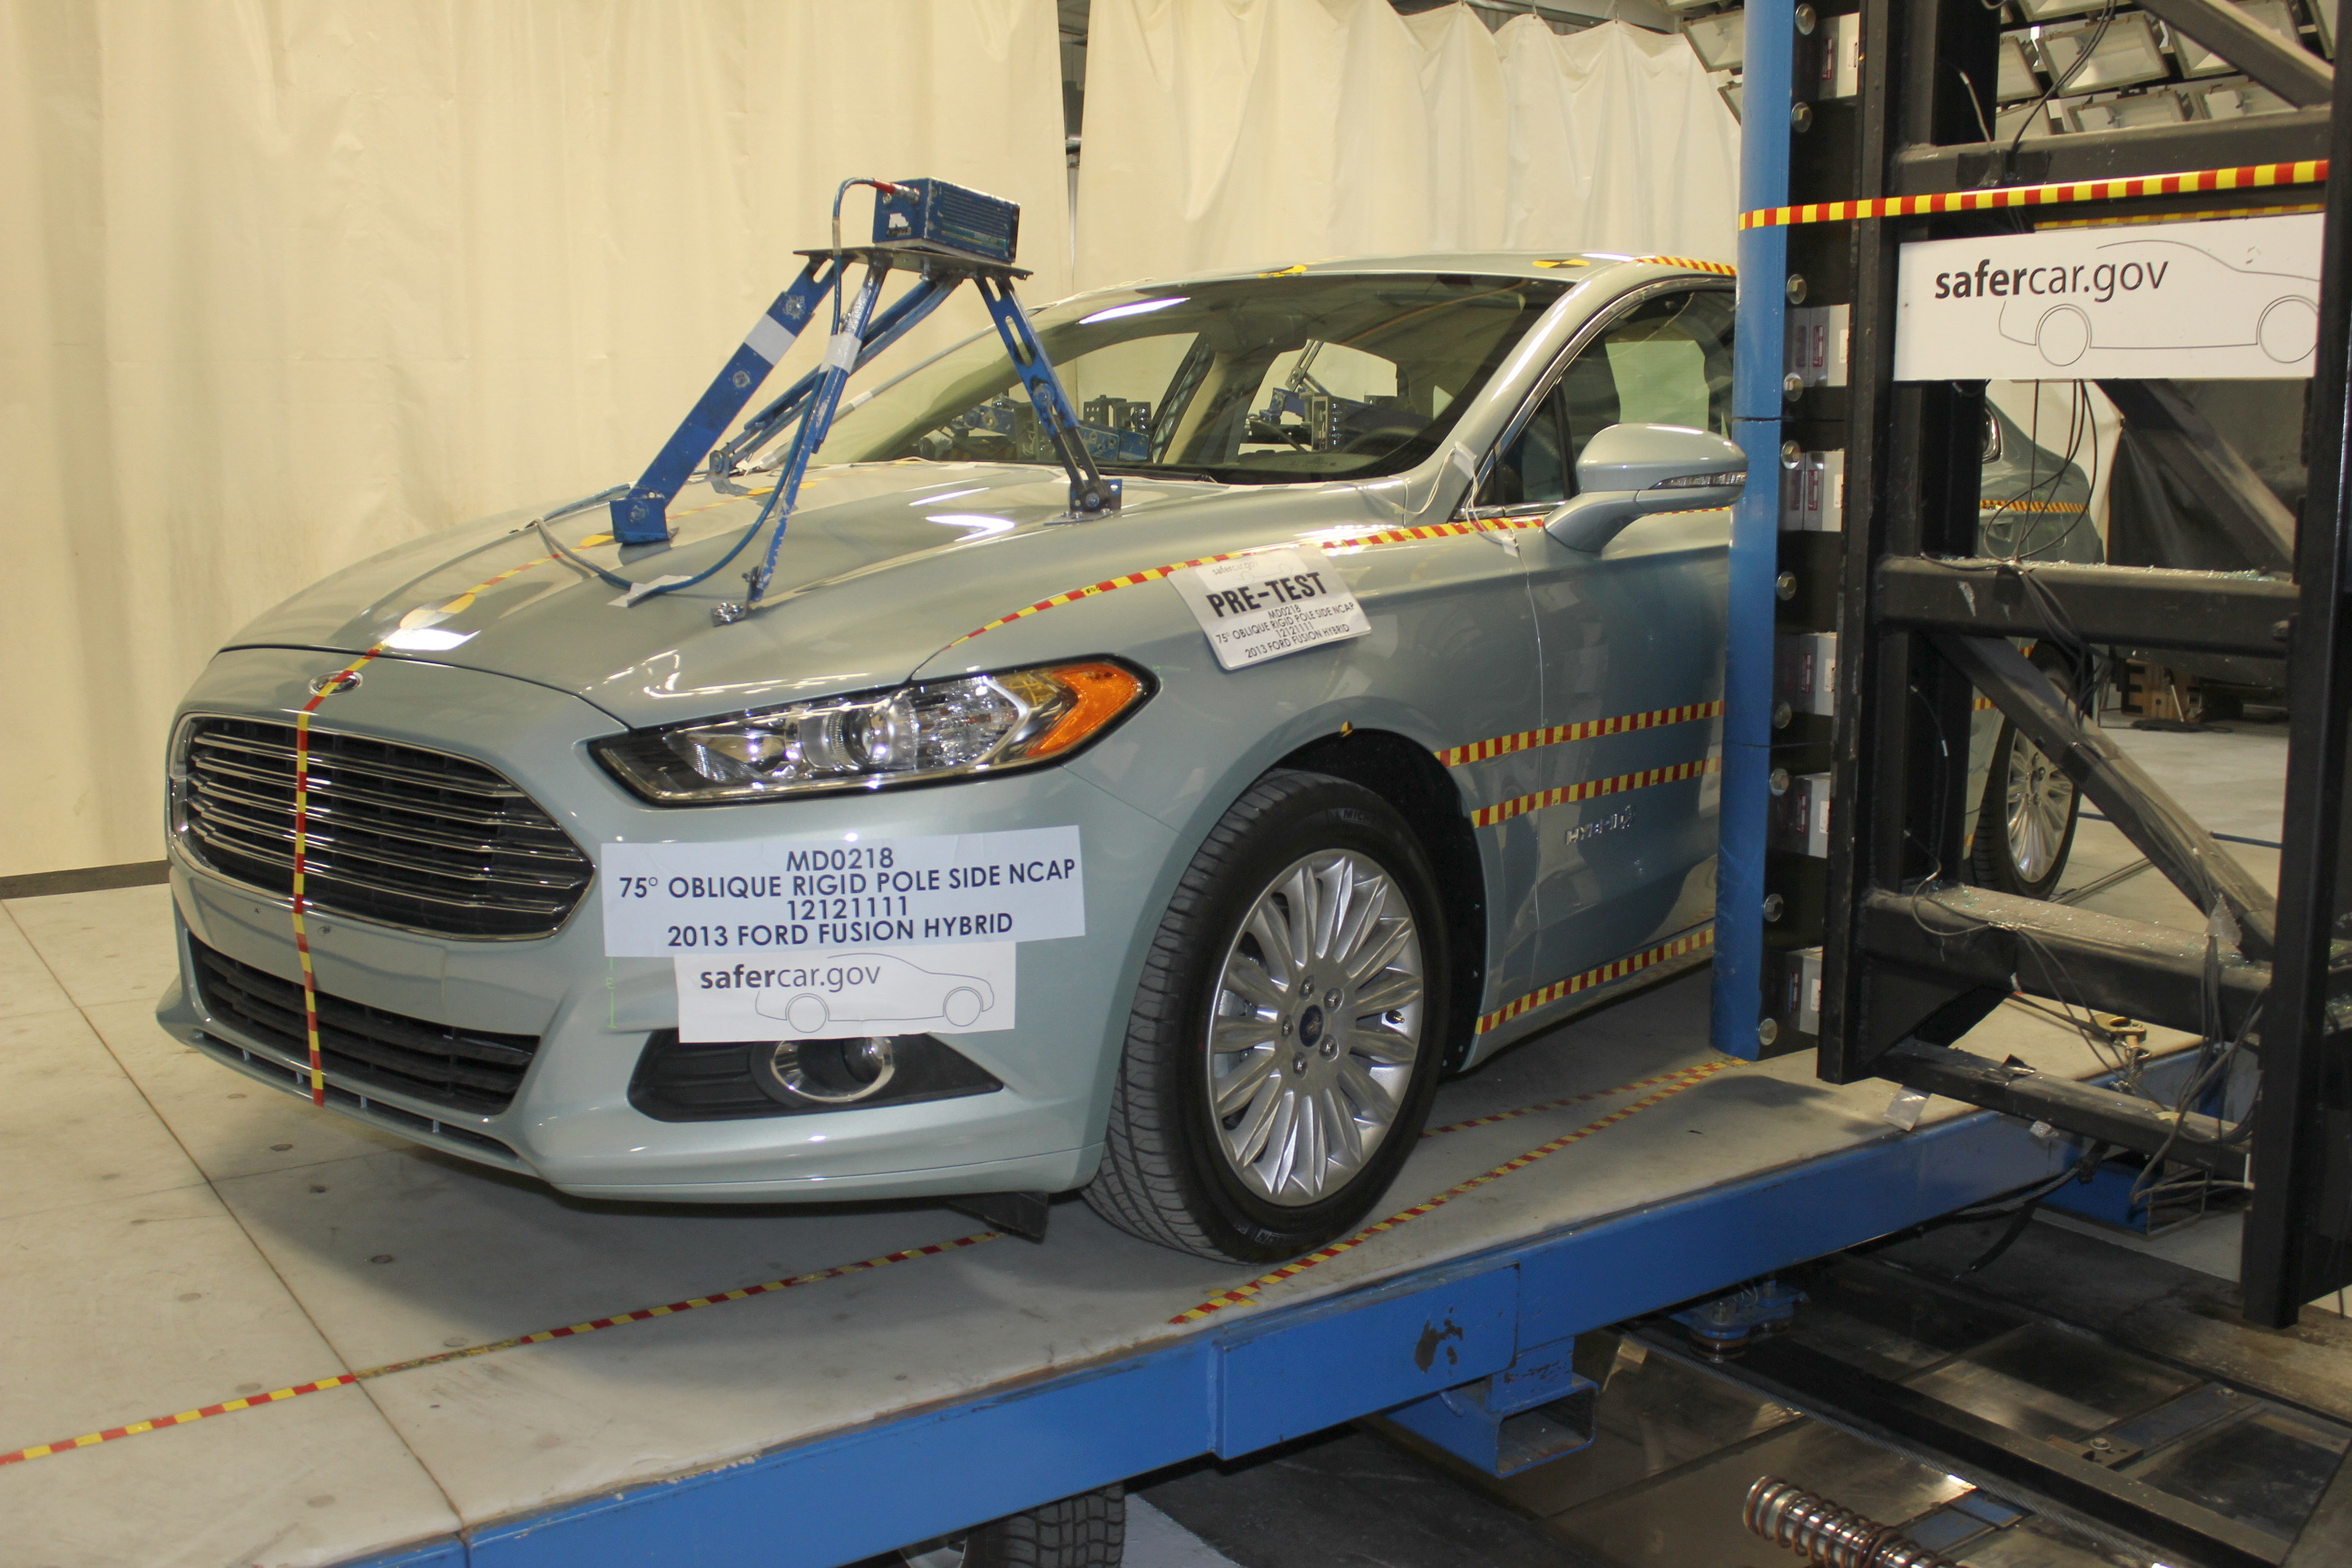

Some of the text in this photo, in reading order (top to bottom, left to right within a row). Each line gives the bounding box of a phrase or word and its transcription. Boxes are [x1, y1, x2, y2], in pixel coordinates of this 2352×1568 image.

[1935, 259, 2169, 302] safercar.gov
[1206, 572, 1328, 618] PRE-TEST
[1268, 604, 1301, 619] MD0218
[1232, 622, 1270, 641] OBLIQUE
[1270, 616, 1294, 630] RIGID
[1295, 612, 1316, 624] POLE
[1315, 607, 1333, 620] SIDE
[1333, 602, 1355, 616] NCAP
[1275, 622, 1314, 639] 12121111
[1245, 624, 1350, 658] 2013 FORD FUSION HYBRID
[786, 848, 895, 872] MD0218
[668, 876, 781, 899] OBLIQUE
[792, 873, 867, 897] RIGID
[877, 869, 940, 893] POLE
[948, 865, 1000, 888] SIDE
[1008, 858, 1075, 885] NCAP
[787, 897, 907, 921] 12121111
[667, 913, 1014, 947] 2013 FORD FUSION HYBRID
[700, 964, 880, 992] safercar.gov
